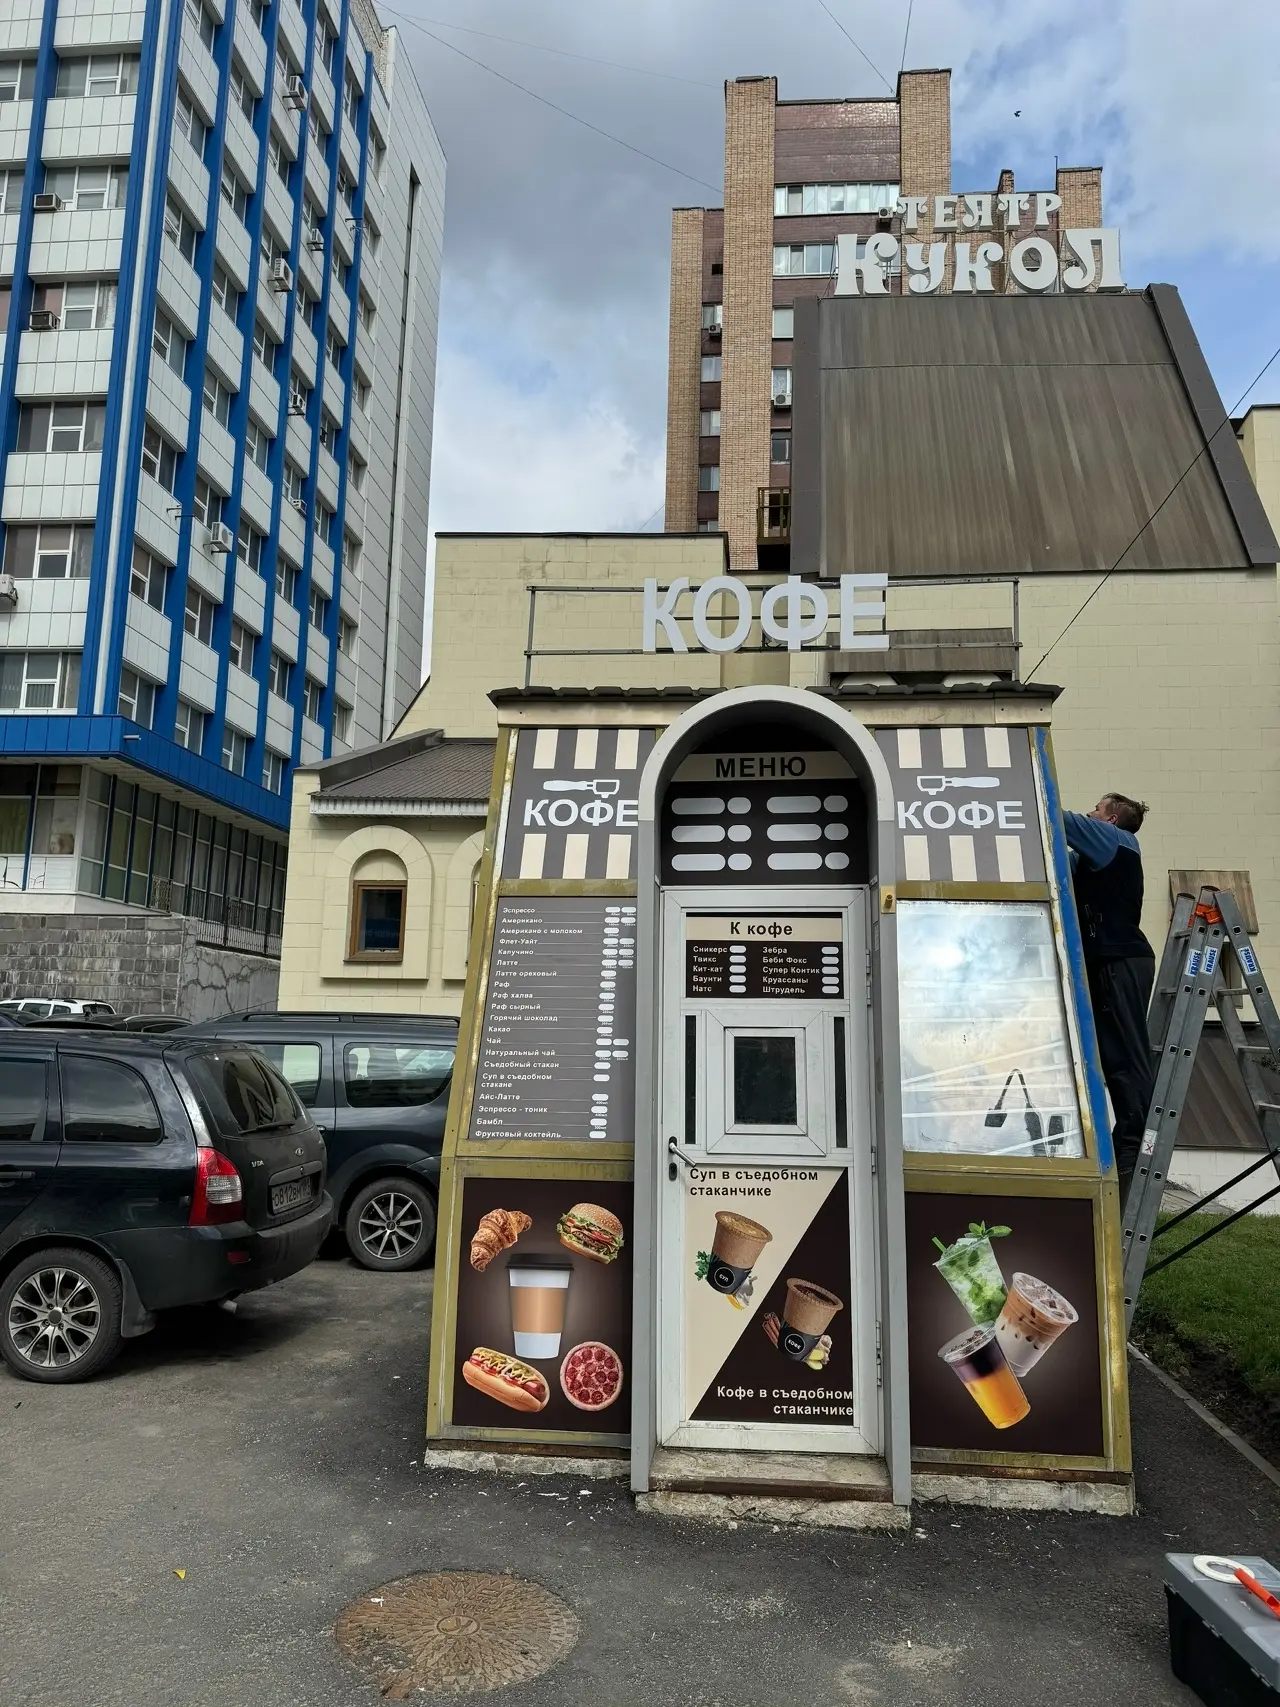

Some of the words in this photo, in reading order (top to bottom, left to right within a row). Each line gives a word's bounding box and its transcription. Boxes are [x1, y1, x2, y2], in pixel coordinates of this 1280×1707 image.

[833, 228, 1126, 296] КУКОЛ
[642, 572, 890, 655] КОФЕ
[715, 757, 807, 778] МЕНЮ
[523, 799, 639, 827] КОФЕ
[897, 800, 1026, 829] КОФЕ
[731, 922, 740, 934] К
[748, 922, 793, 938] кофе
[1190, 951, 1201, 976] KRAUSE
[1205, 949, 1217, 973] KRAUSE
[1244, 948, 1256, 973] KRAUSE
[693, 975, 722, 983] Баунти
[763, 986, 805, 994] Штрудель
[475, 1130, 521, 1138] Фруктовый
[524, 1130, 561, 1138] коктейль
[690, 1168, 716, 1182] Суп
[723, 1170, 729, 1179] в
[736, 1170, 818, 1182] съедобном
[690, 1186, 772, 1196] стаканчике
[717, 1386, 753, 1399] Кофе
[760, 1389, 767, 1398] в
[772, 1388, 853, 1400] съедобном
[773, 1404, 853, 1415] стаканчике
